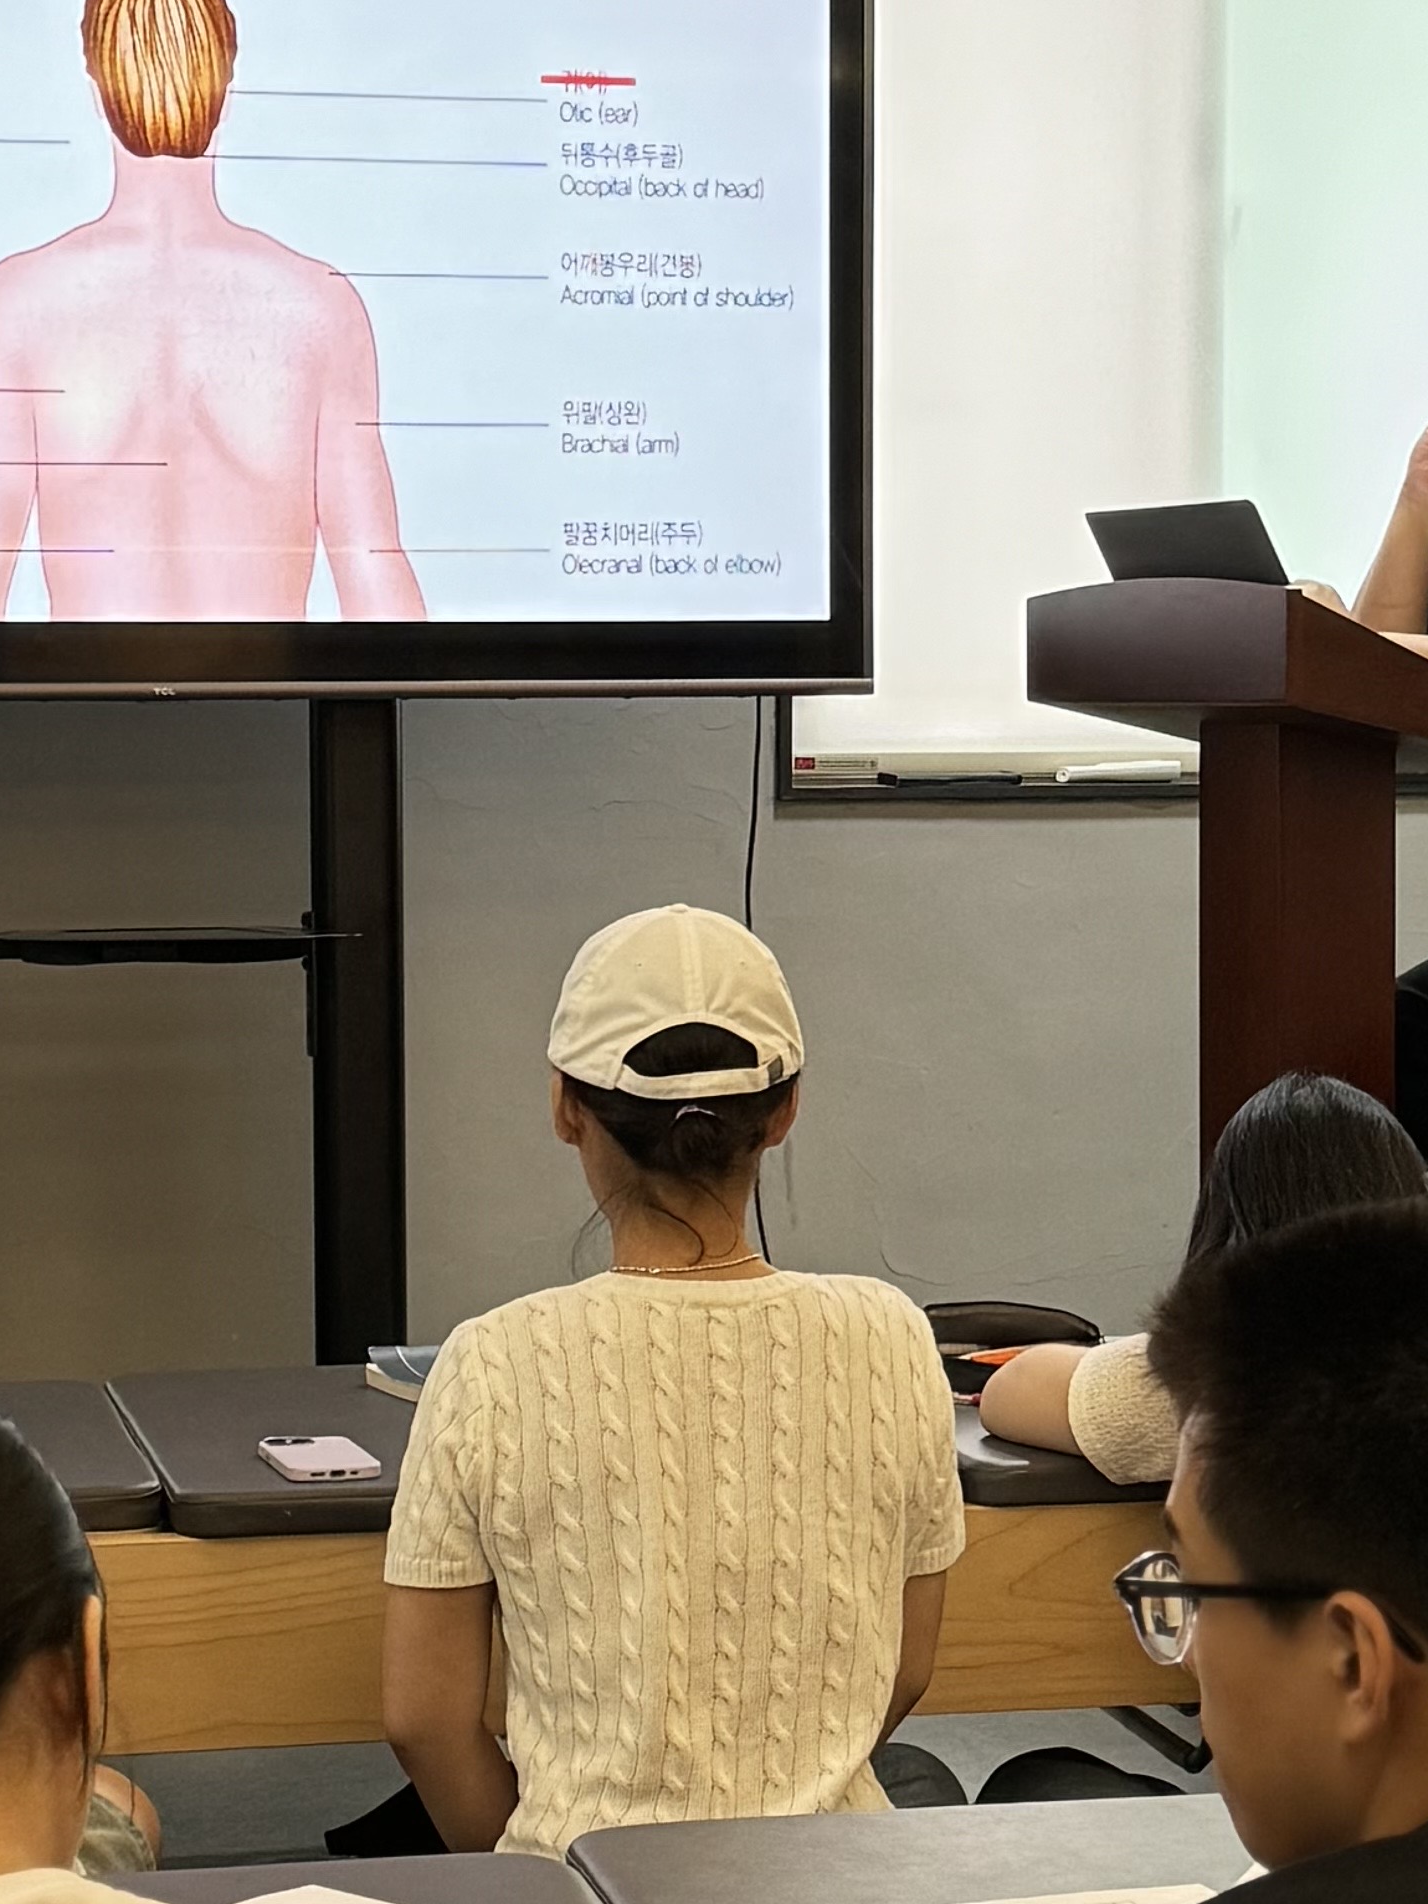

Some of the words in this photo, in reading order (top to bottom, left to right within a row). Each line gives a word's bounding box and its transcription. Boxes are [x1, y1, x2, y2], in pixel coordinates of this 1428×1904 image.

[599, 101, 638, 127] (ear)
[715, 178, 764, 199] head)
[641, 283, 687, 308] (point
[716, 285, 794, 310] shoulder)
[636, 431, 679, 457] (arm)
[650, 553, 697, 576] (back
[725, 553, 781, 576] elbow)
[154, 687, 176, 696] TCL
